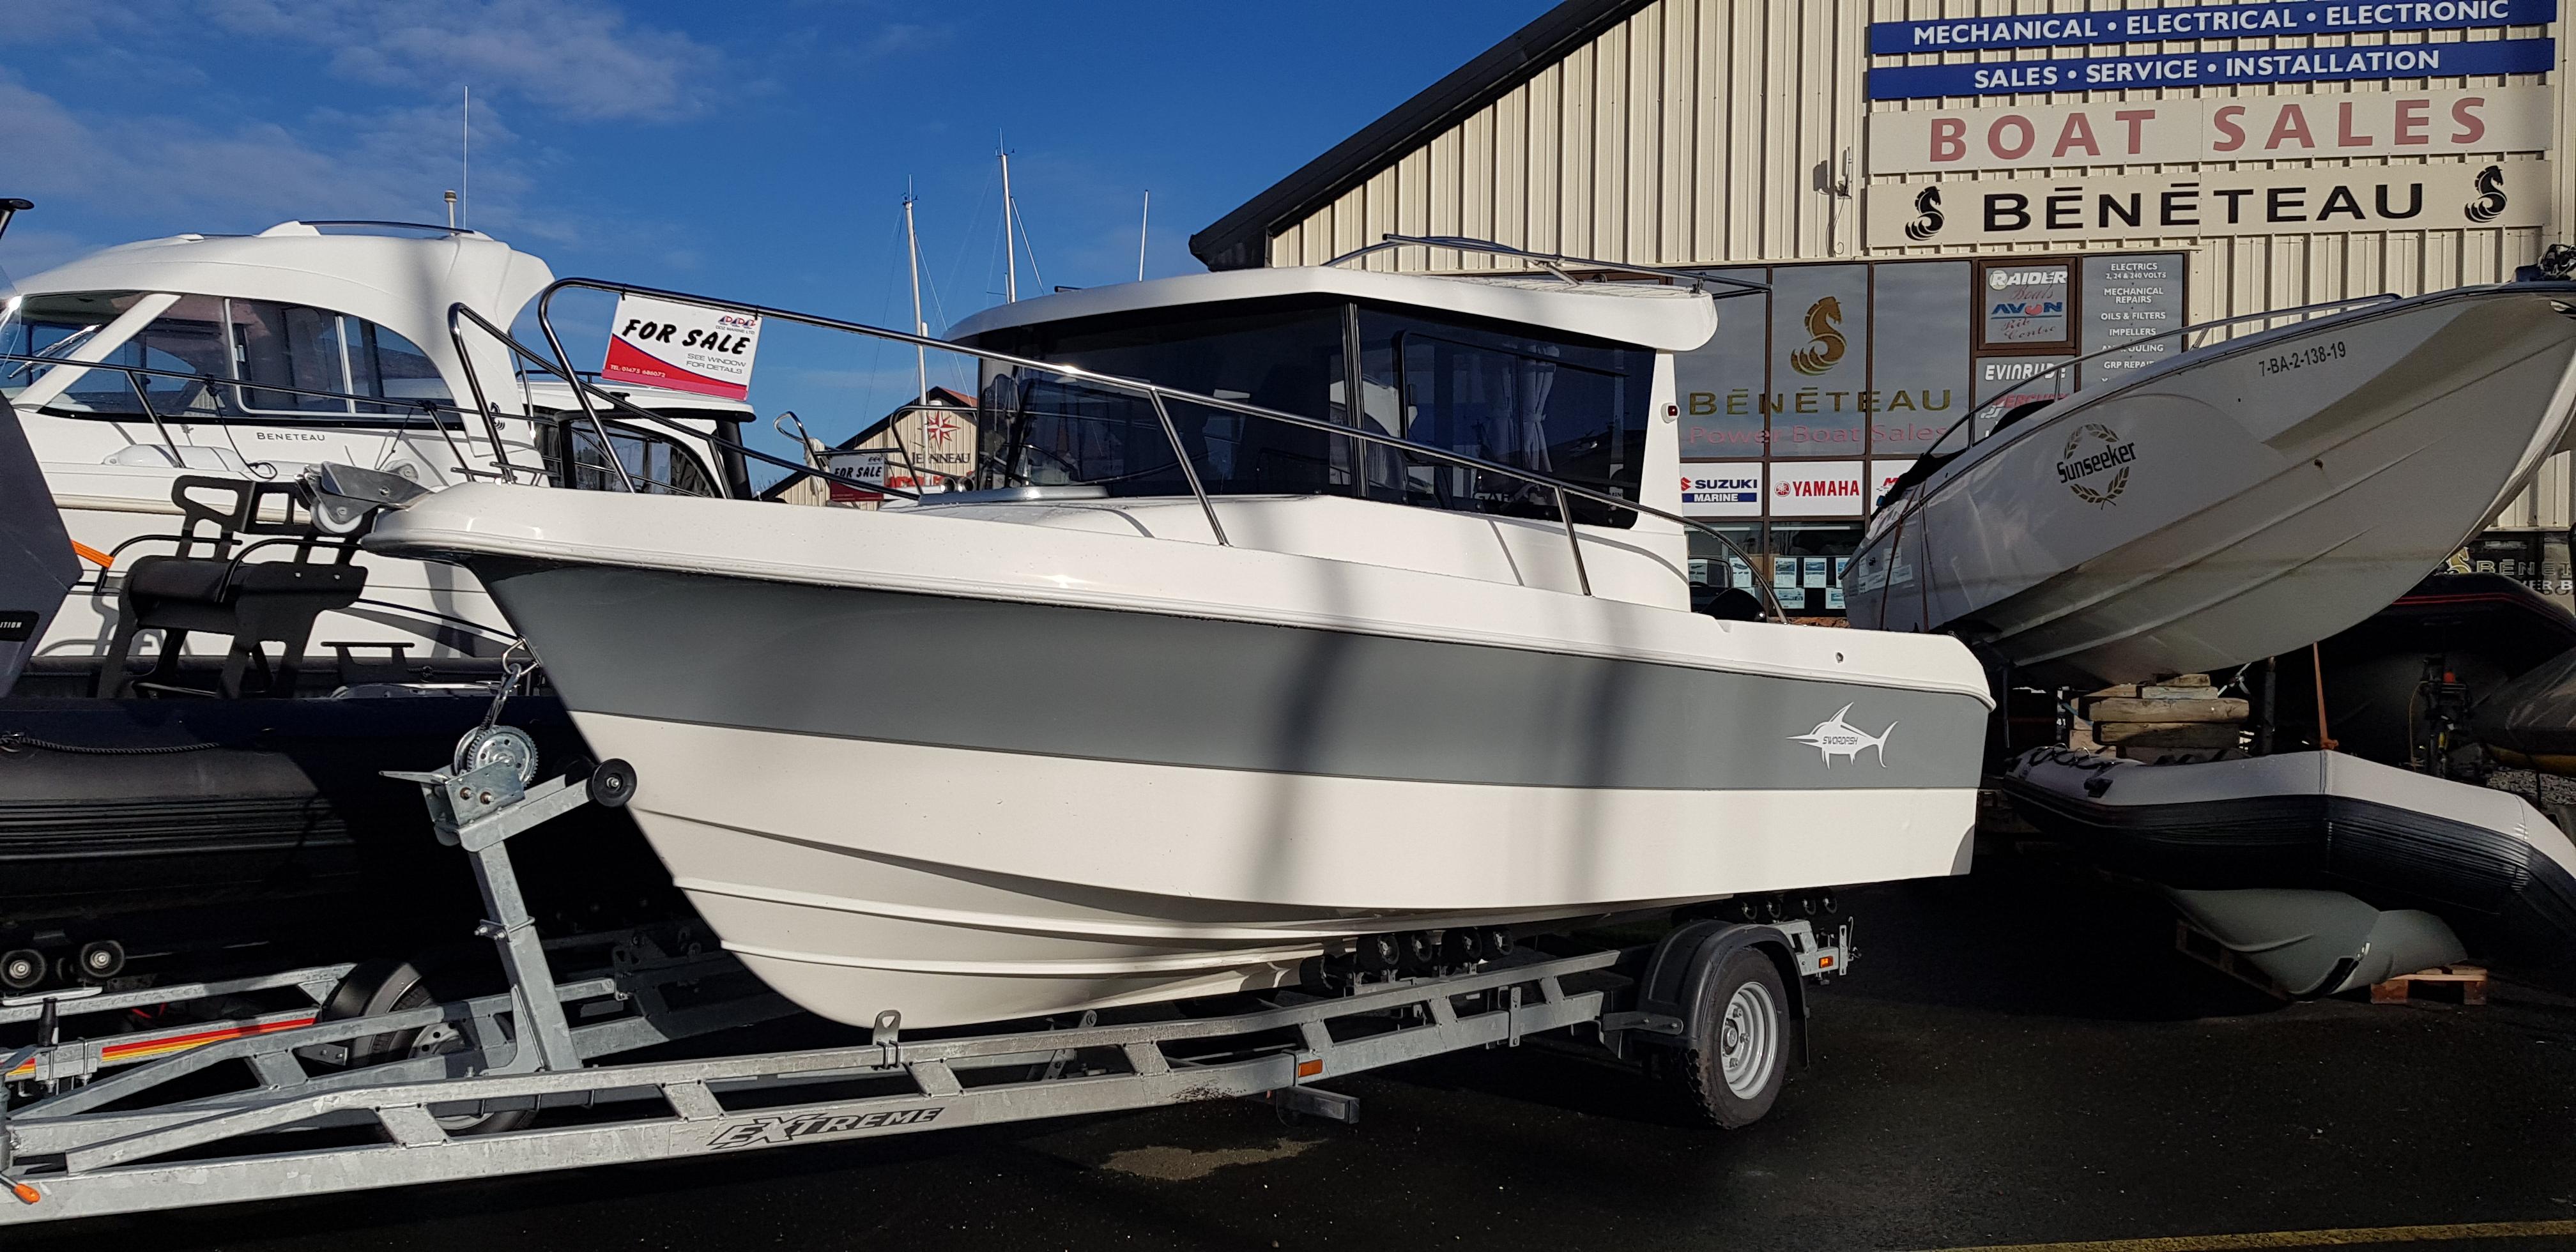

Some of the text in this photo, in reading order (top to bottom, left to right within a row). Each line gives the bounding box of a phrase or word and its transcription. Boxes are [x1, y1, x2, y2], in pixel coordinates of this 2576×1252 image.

[1913, 1, 2508, 45] MECHANICAL ELECTRICAL ELECTRONIC
[1975, 50, 2439, 89] SALES SERVICE INSTALLATION
[1929, 97, 2485, 162] BOAT SALES
[2111, 263, 2158, 271] ELECTRICS
[1990, 271, 2067, 287] RAIDER
[2104, 287, 2164, 296] MECHANICAL
[2115, 296, 2152, 304] REPAIRS
[2132, 312, 2166, 320] FILTERS
[621, 319, 751, 355] FOR SALE
[2102, 344, 2164, 353] AOULING
[687, 353, 747, 367] SEE WINDOW
[2258, 341, 2346, 376] 7-BA-2-138-19
[686, 360, 742, 374] FOR DETAILS
[256, 432, 325, 441] BENETEAU
[1690, 423, 1949, 444] Power Boat Sales
[912, 452, 970, 465] JENNEAU
[2057, 442, 2136, 484] Sunseeker
[834, 466, 882, 478] FOR SALE
[1695, 479, 1758, 489] SUZUKI
[1793, 480, 1860, 496] YAMAHA
[1694, 493, 1738, 503] MARINE
[1822, 736, 1859, 745] SWORDFISH
[706, 1107, 946, 1150] EXTREME
